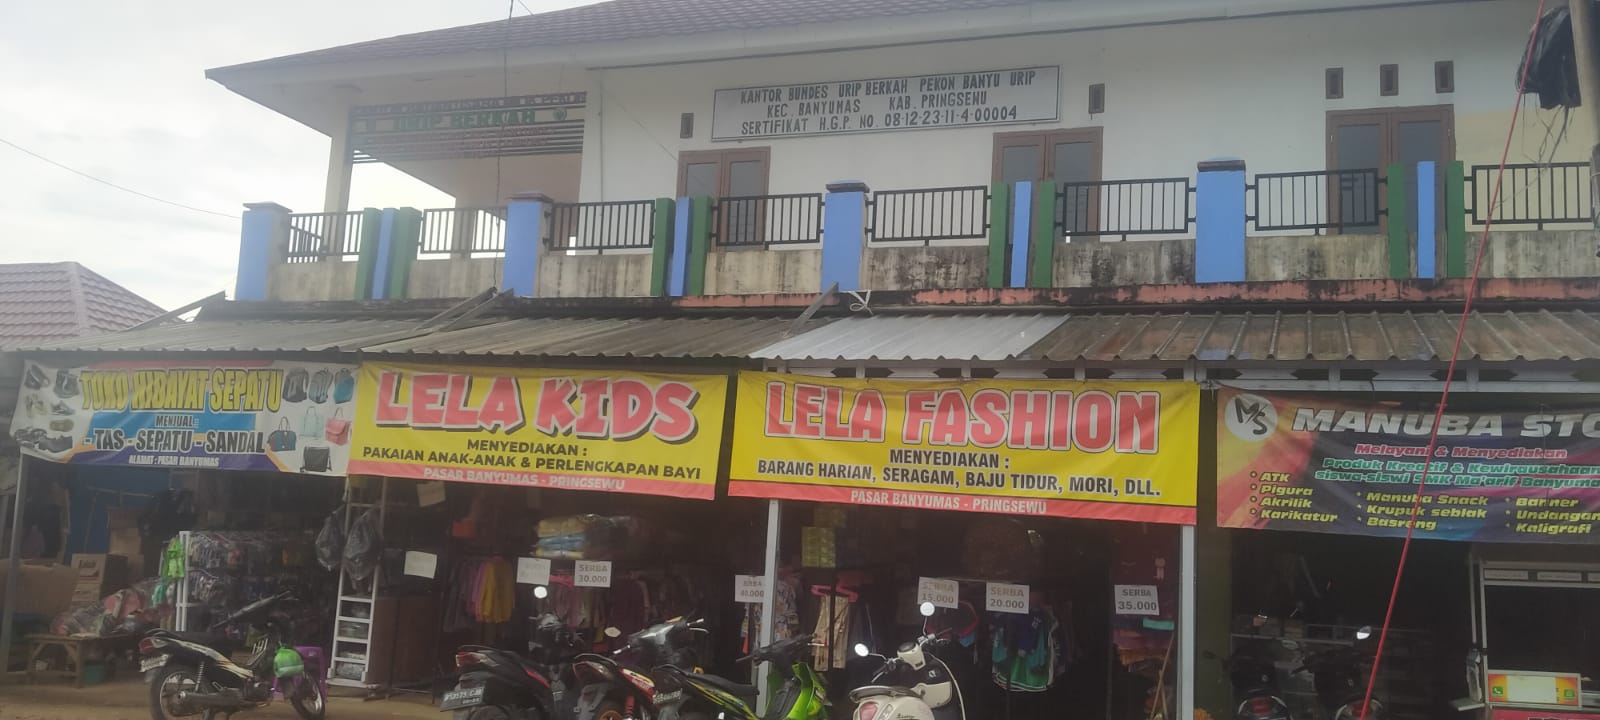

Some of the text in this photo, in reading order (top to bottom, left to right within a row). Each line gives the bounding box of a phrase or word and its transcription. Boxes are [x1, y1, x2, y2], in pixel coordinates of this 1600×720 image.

[741, 87, 782, 105] KANTOR
[838, 81, 862, 98] URIP
[865, 79, 908, 96] BERKAH
[919, 76, 955, 92] PEKON
[962, 73, 1000, 90] BANYU
[1009, 70, 1036, 86] URIP
[798, 98, 861, 116] BANYUMAS
[741, 118, 808, 135] SERTIFIKAT
[80, 370, 129, 411] TOKO
[211, 368, 284, 412] SEPATU
[376, 371, 700, 444] LELA KIDS
[156, 415, 194, 427] MENJUAL
[764, 381, 1160, 454] LELA FASHION
[1292, 407, 1503, 437] MANUBA
[94, 430, 124, 450] TAS
[136, 430, 193, 451] SEPATU
[206, 431, 266, 453] SANDAL
[467, 439, 578, 456] MENYEDIAKAN
[889, 448, 999, 468] MENYEDIAKAN
[1355, 444, 1568, 459] Melayani & Menyediakan
[180, 457, 219, 467] BANYUMAS
[362, 446, 702, 480] PAKAIAN ANAK-ANAK & PERLENGKAPAN BAYI
[1322, 458, 1384, 470] Produk
[1386, 461, 1448, 472] Kreatif
[1450, 463, 1464, 473] &
[424, 467, 464, 480] PASAR
[466, 470, 539, 485] BANYUMAS
[549, 475, 626, 490] PRINGSEWU
[757, 459, 1161, 497] BARANG HARIAN, SERAGAM, BAJU TIDUR, MORI, DLL.
[1260, 472, 1290, 482] ATK
[1315, 470, 1410, 483] siswa-siswi
[1412, 474, 1452, 485] SMK
[1455, 475, 1519, 487] Ma'arif
[1260, 484, 1313, 496] Pigura
[851, 490, 889, 504] PASAR
[892, 492, 960, 508] BANYUMAS
[972, 498, 1047, 514] PRINGSEWU
[1260, 497, 1313, 508] Akrilik
[1366, 492, 1488, 506] Manuba Snack
[1260, 509, 1338, 522] Karikatur
[1366, 505, 1488, 518] Krupuk seblak
[1516, 510, 1600, 522] Undangan
[1366, 517, 1437, 530] Basreng
[1515, 523, 1592, 535] Kaligrafi
[579, 564, 608, 572] SERBA
[579, 575, 608, 583] 30.000
[922, 593, 954, 604] 15.000
[991, 587, 1024, 597] SERBA
[1122, 588, 1151, 596] SERBA
[990, 599, 1025, 609] 20.000
[1118, 601, 1157, 610] 35.000
